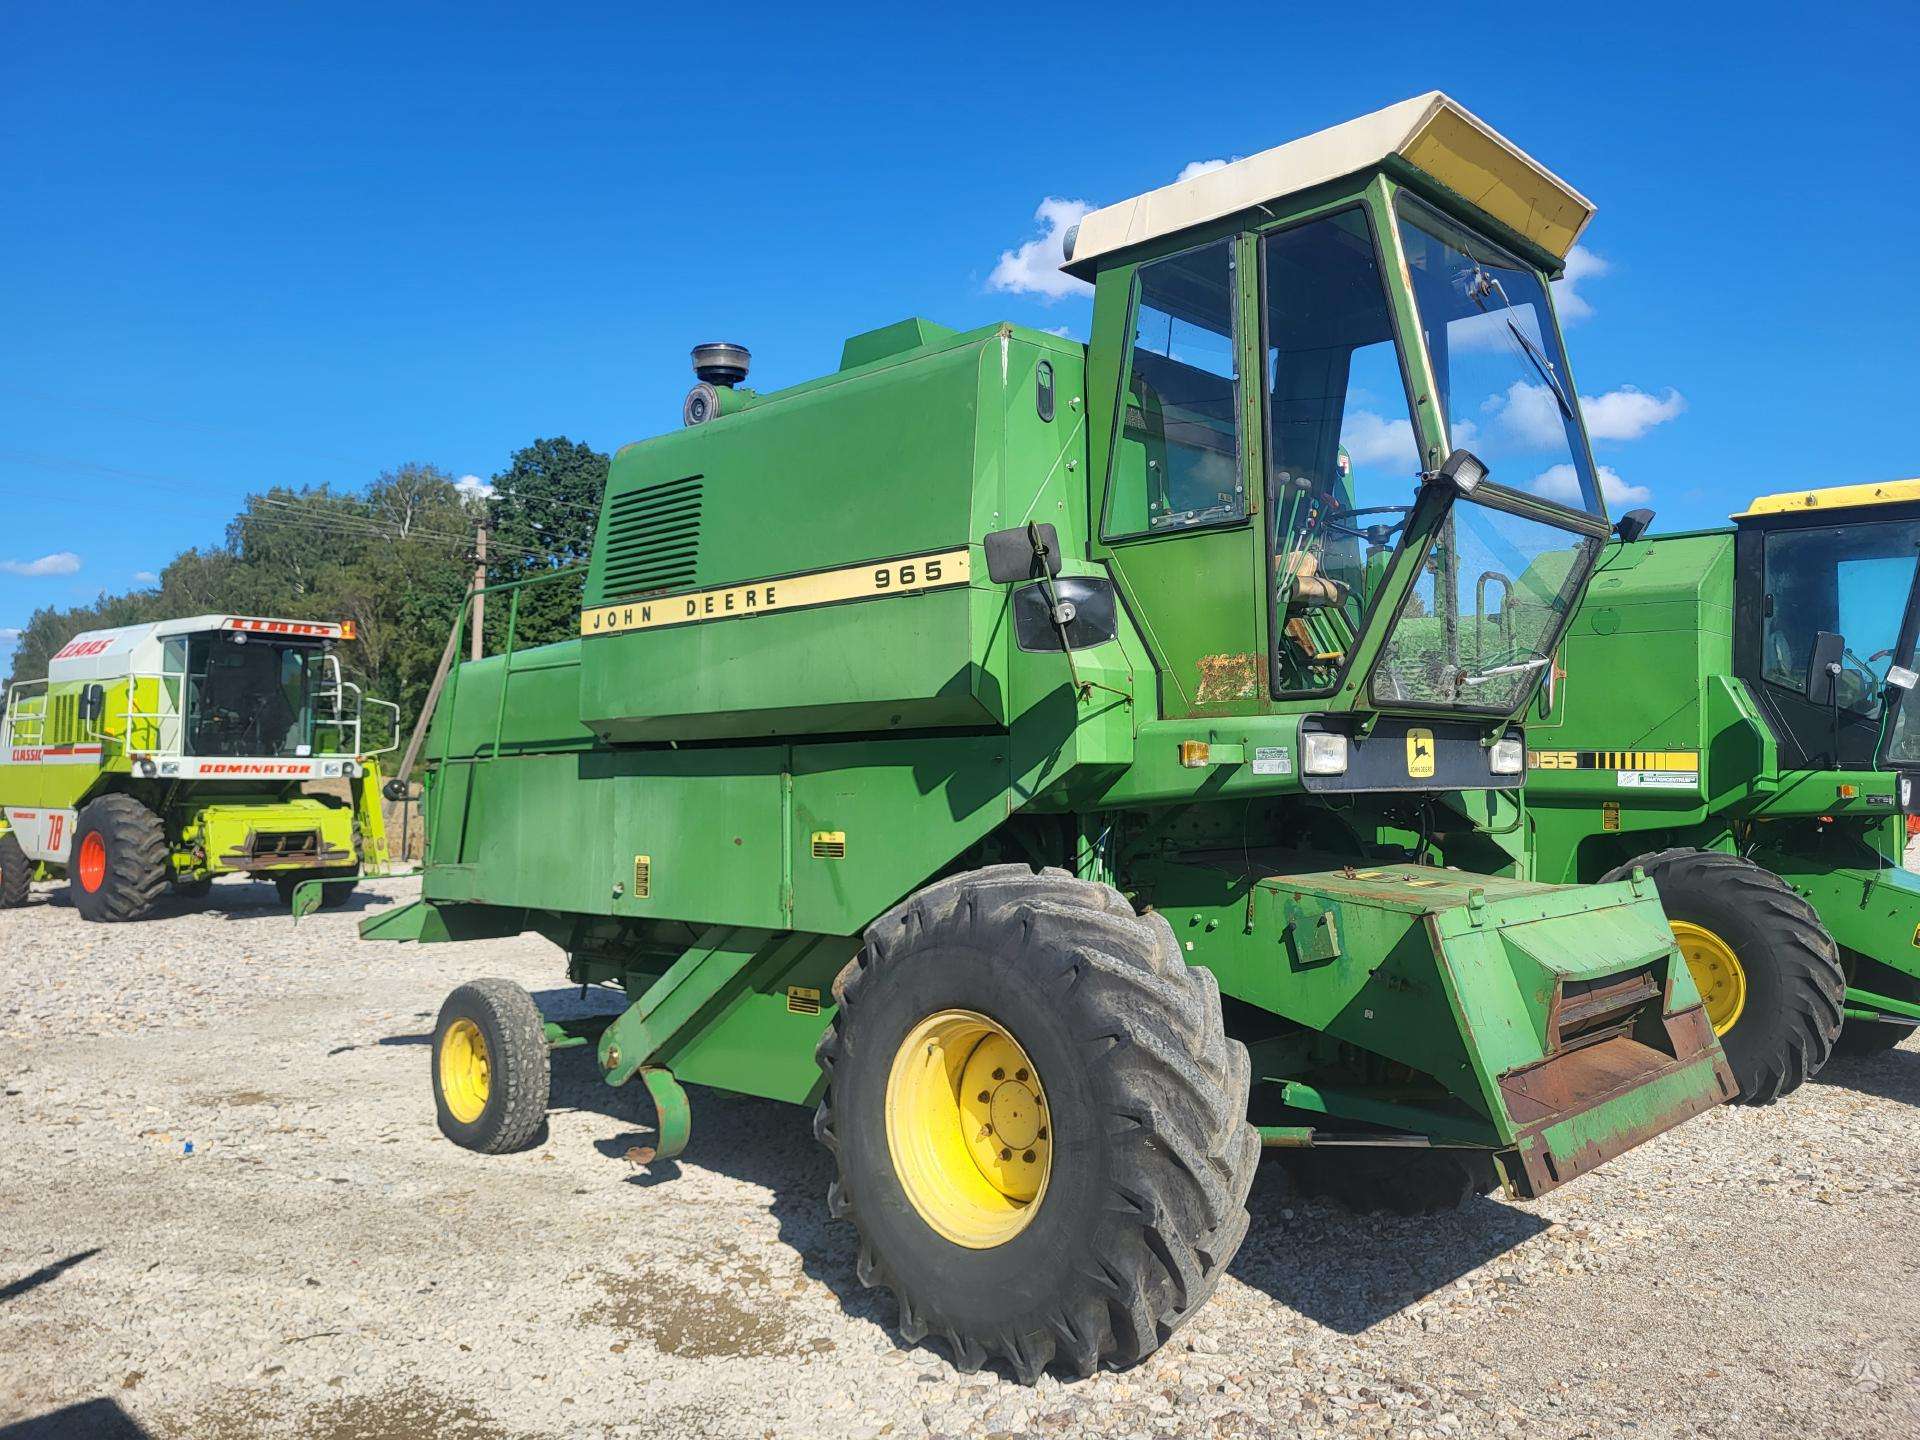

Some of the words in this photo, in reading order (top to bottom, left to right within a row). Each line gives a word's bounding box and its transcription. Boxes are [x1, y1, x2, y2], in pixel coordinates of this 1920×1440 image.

[593, 606, 651, 629] JOHN
[686, 587, 776, 616] DEERE
[874, 560, 942, 588] 965
[231, 619, 330, 635] CLAAS
[55, 638, 115, 659] CLAAS
[12, 749, 42, 761] CLASSIC
[199, 764, 311, 774] DOMINATOR
[47, 814, 64, 851] 78
